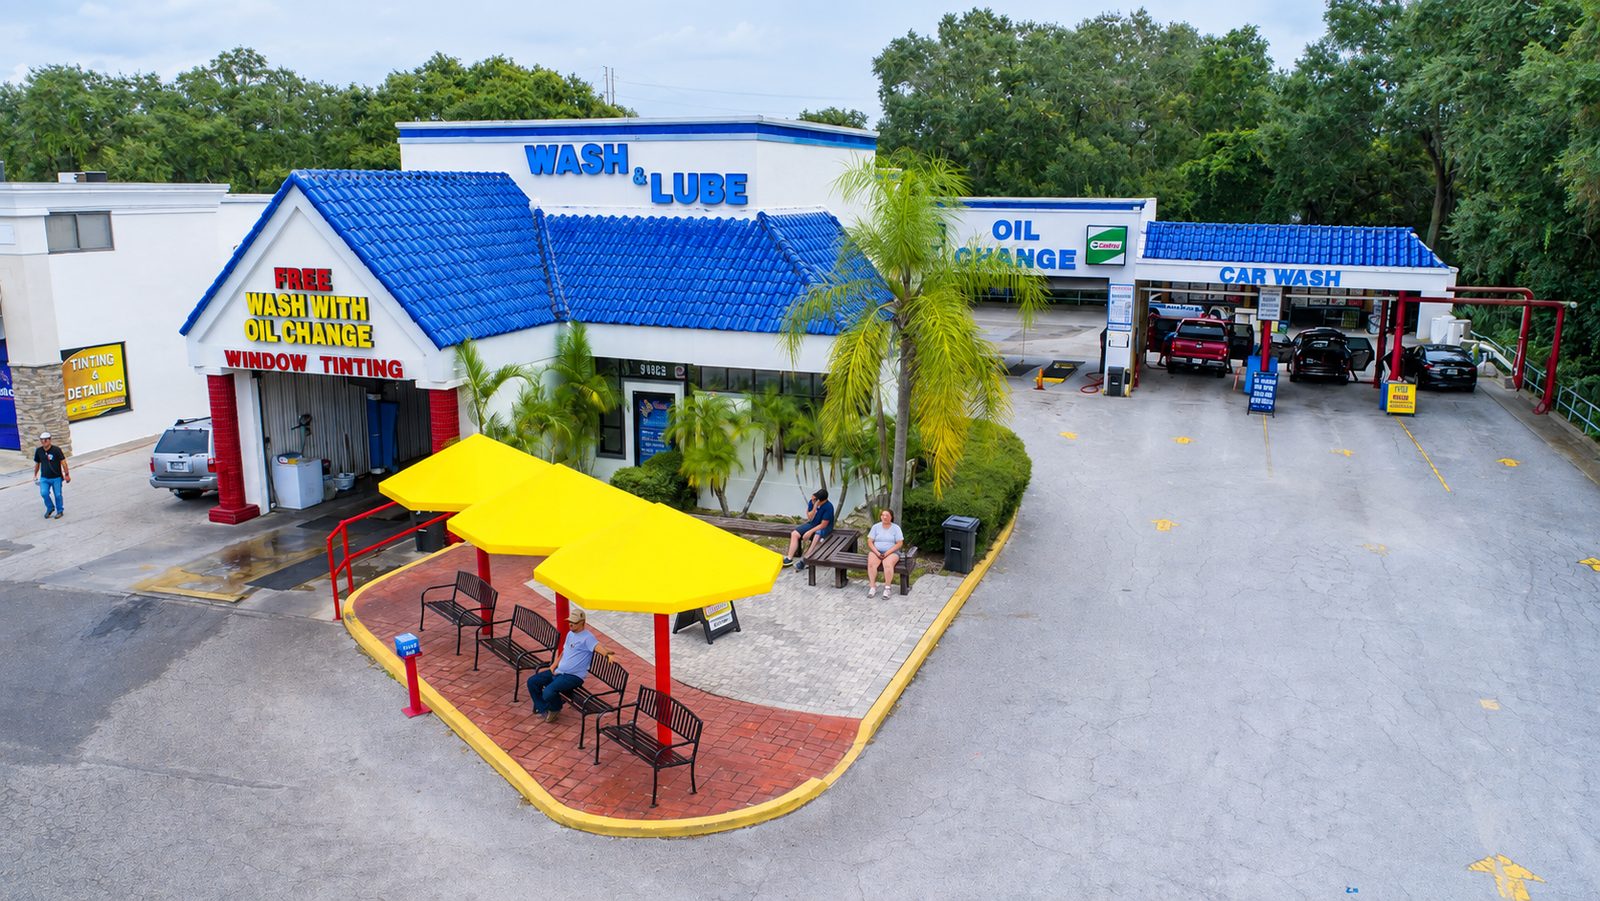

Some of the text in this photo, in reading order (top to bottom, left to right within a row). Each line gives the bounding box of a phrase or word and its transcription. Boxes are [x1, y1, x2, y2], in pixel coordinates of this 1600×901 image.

[524, 143, 748, 205] WASH & LUBE
[992, 219, 1040, 241] OIL
[274, 267, 333, 291] FREE
[1219, 266, 1342, 287] CAR WASH
[245, 292, 370, 321] WASH WITH
[244, 319, 374, 348] OIL CHANGE
[70, 353, 114, 371] TINTING
[224, 350, 404, 378] WINDOW TINTING
[92, 371, 99, 380] &
[68, 379, 123, 400] DETAILING
